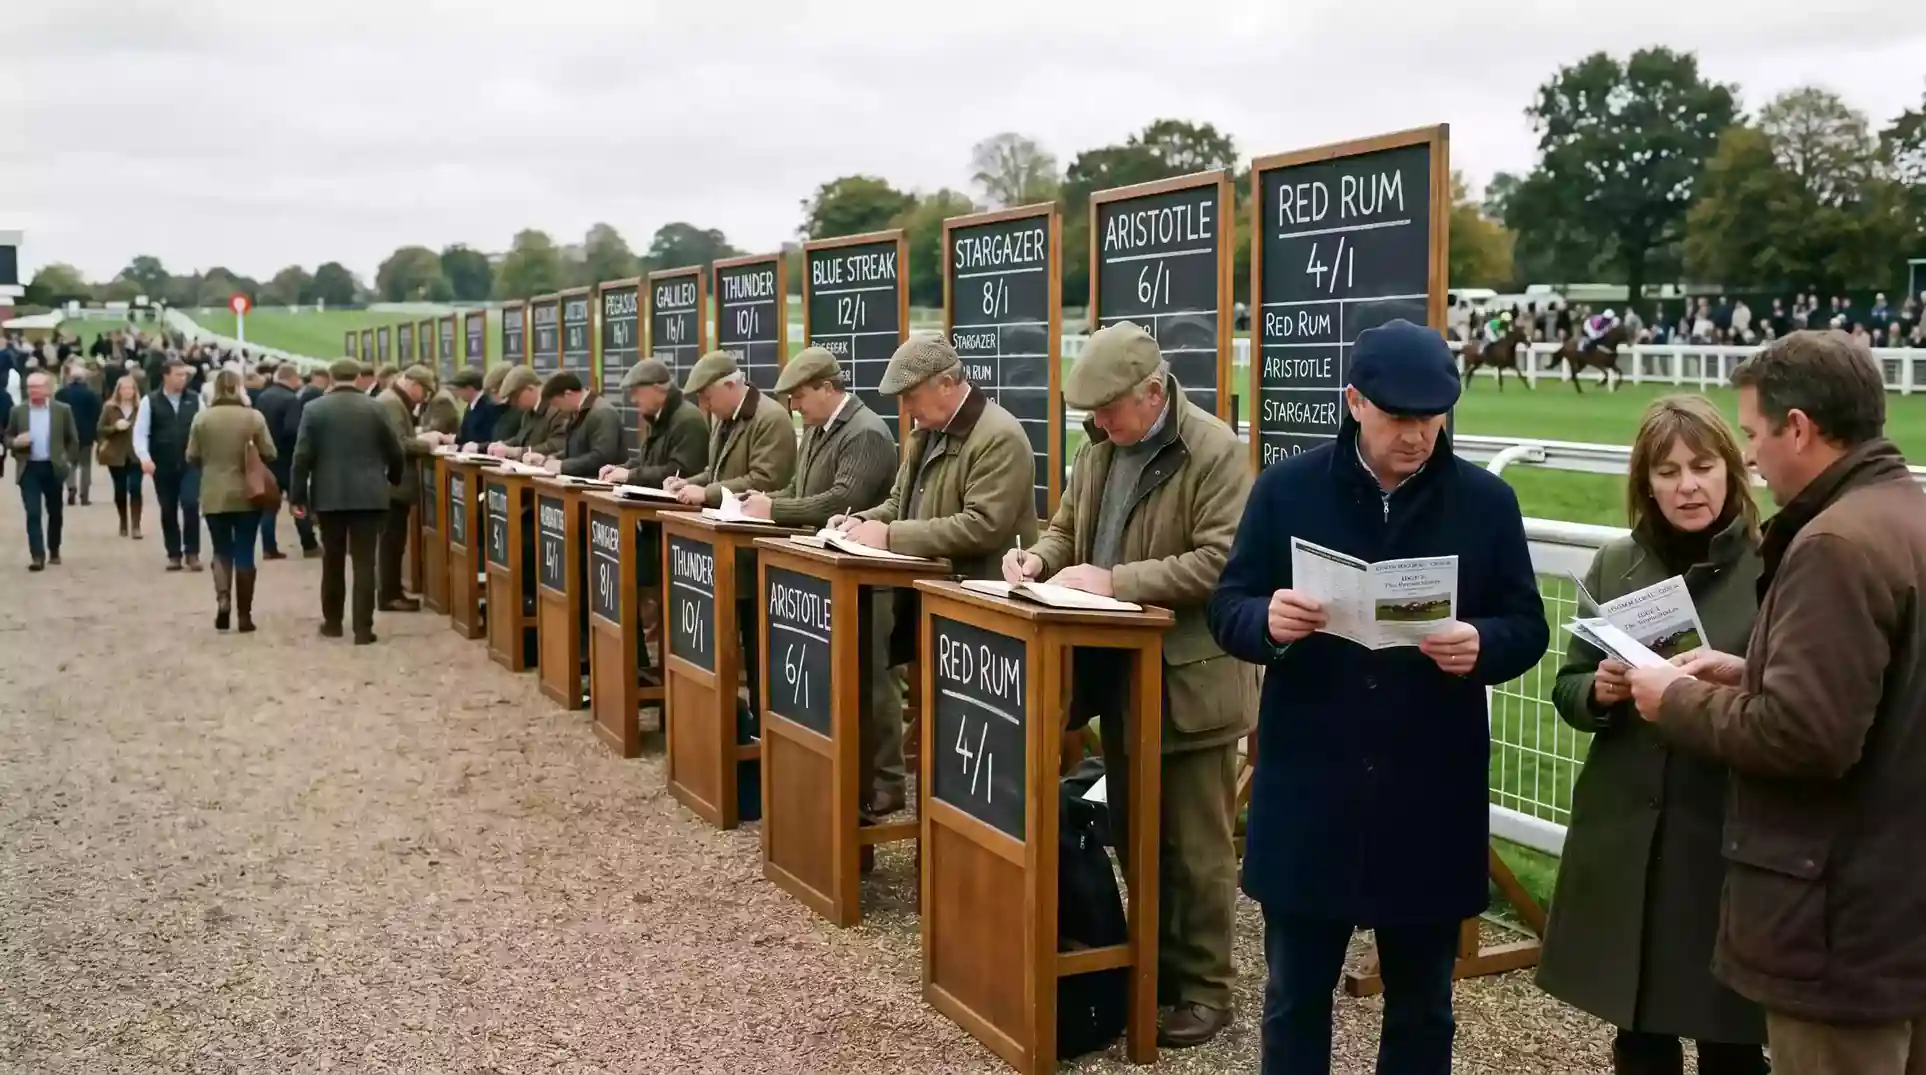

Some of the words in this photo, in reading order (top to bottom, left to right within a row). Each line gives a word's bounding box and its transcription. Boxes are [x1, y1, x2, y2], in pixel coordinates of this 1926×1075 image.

[1279, 180, 1329, 227] RED
[1341, 169, 1404, 219] RUM
[1104, 200, 1212, 252] ARISTOTLE
[812, 257, 843, 286] BLUE
[847, 252, 896, 282] STREAK
[955, 228, 1045, 269] STARGAZER
[1305, 236, 1354, 293] 4/1
[656, 283, 696, 309] GALILEO
[722, 270, 775, 301] THUNDER
[982, 278, 1009, 318] 8/1
[1138, 260, 1170, 309] 6/1
[736, 306, 759, 339] 10/1
[838, 293, 866, 330] 12/1
[1265, 312, 1293, 337] RED
[1298, 311, 1331, 336] RUM
[952, 332, 997, 350] STARGAZER
[1263, 356, 1332, 379] ARISTOTLE
[1263, 399, 1337, 425] STARGAZER
[600, 563, 613, 610] 8/1
[671, 545, 714, 587] THUNDER
[682, 599, 704, 652] 10/1
[769, 582, 832, 632] ARISTOTLE
[785, 643, 809, 709] 6/1
[939, 633, 973, 684] RED
[980, 644, 1021, 706] RUM
[955, 714, 993, 804] 4/1
